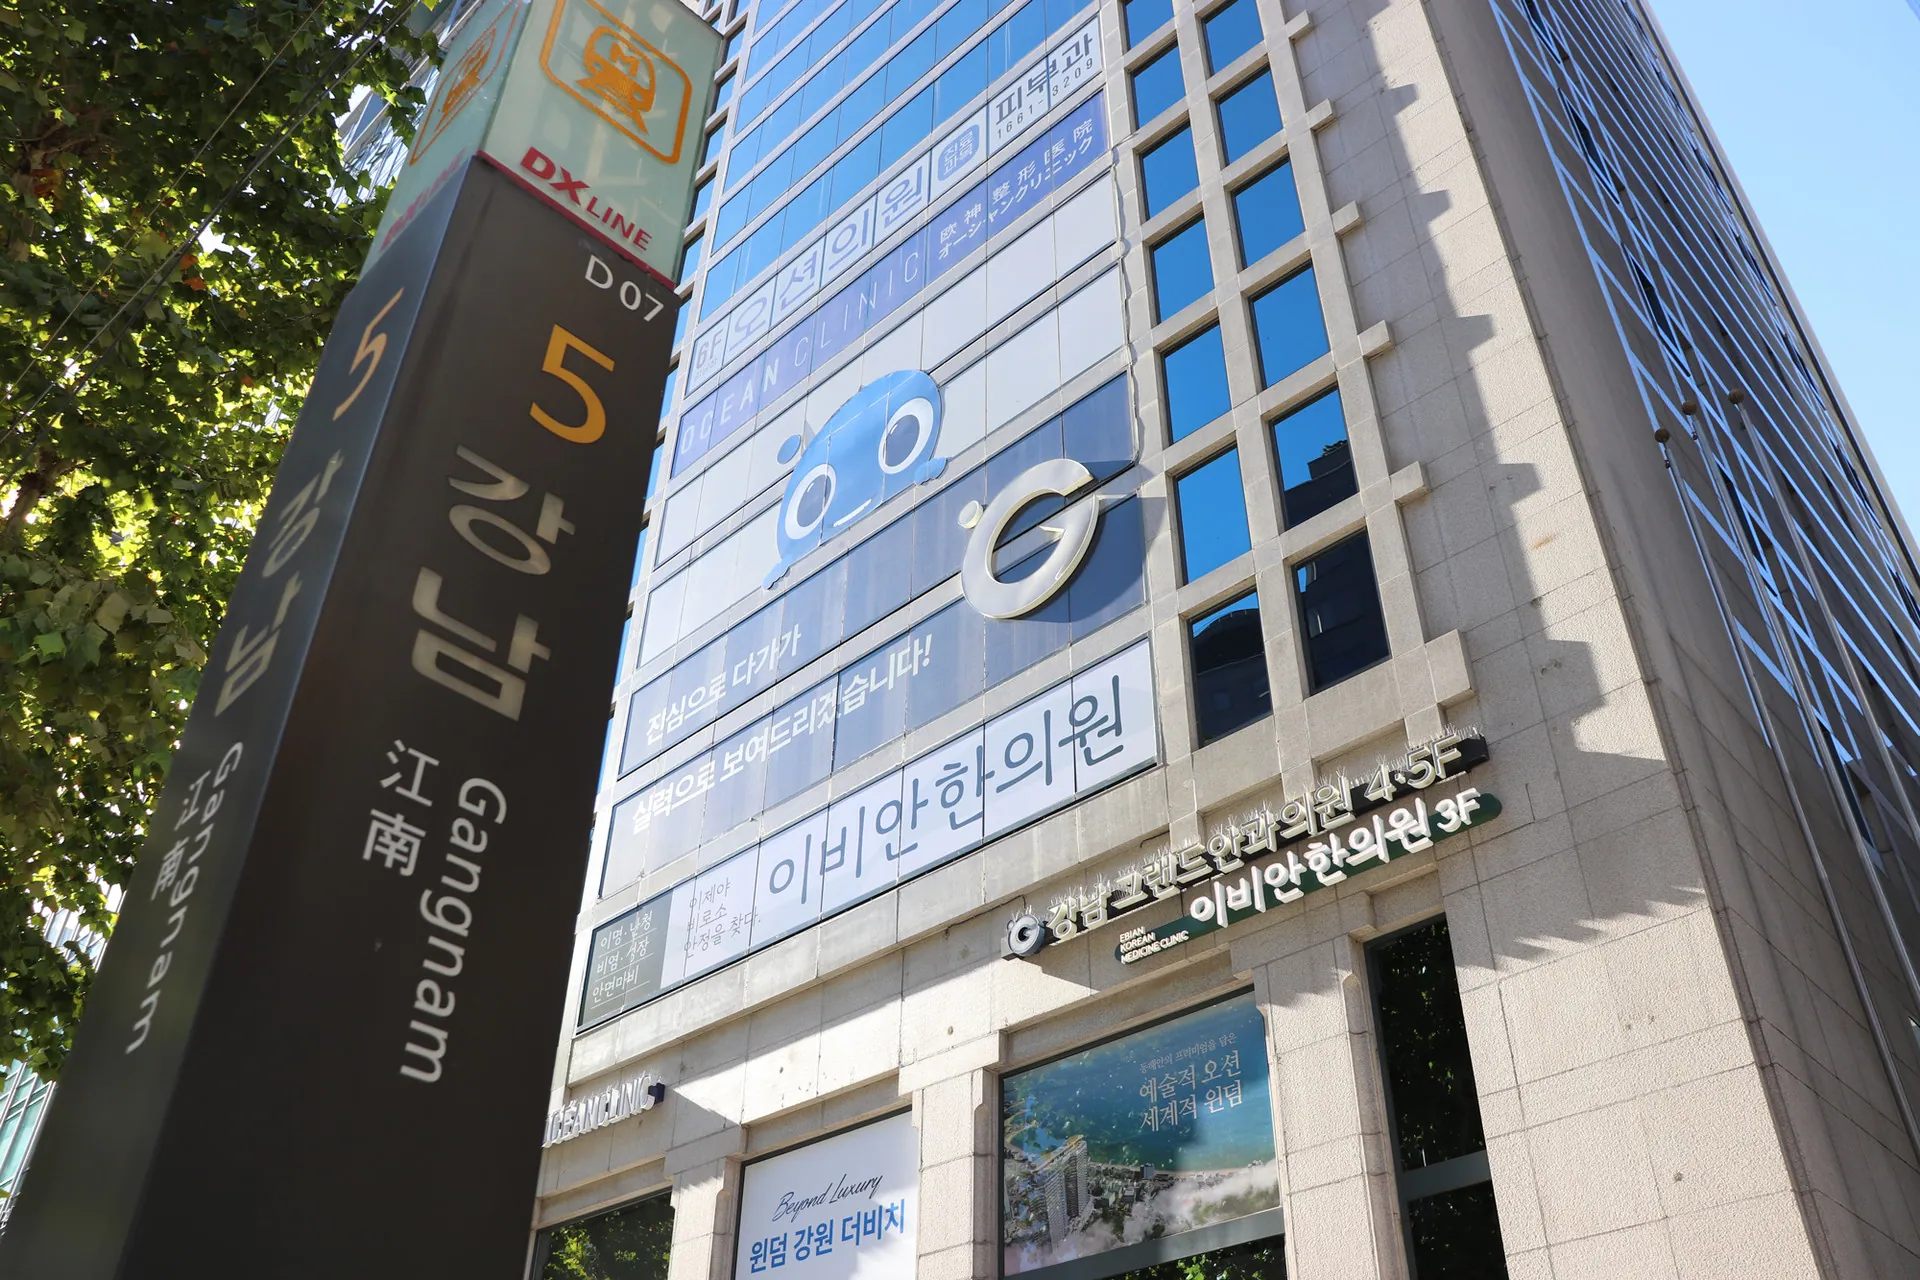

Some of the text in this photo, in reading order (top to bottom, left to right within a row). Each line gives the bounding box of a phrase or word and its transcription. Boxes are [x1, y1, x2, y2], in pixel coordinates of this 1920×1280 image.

[995, 33, 1093, 125] 피부과
[997, 57, 1093, 140] 1661-3209
[729, 165, 923, 352] 오션의원
[333, 287, 404, 421] 5
[529, 324, 615, 444] 5
[680, 252, 919, 456] OCEAN CLINIC
[696, 329, 723, 369] 6F
[215, 449, 344, 717] 강남
[412, 445, 575, 721] 강남
[646, 624, 802, 746] 진심으로 다가가
[632, 633, 932, 836] 실력으로 보여드리겠습니다!
[363, 739, 440, 877] 江南
[769, 675, 1124, 905] 이비안한의원
[126, 742, 243, 1054] Gangnam
[689, 878, 731, 910] 이제야
[1190, 787, 1481, 928] 이비안한의원 3F
[400, 777, 507, 1083] Gangnam
[684, 905, 761, 959] 안정을 찾다.
[687, 903, 727, 934] 비로소
[1120, 926, 1146, 943] EBIAN
[1120, 932, 1156, 954] KOREAN
[1121, 930, 1189, 964] MEDICINE CLINIC
[592, 964, 639, 1003] 안면마비
[1139, 1050, 1241, 1103] 예술적 오션
[1140, 1079, 1243, 1132] 세계적 윈덤
[750, 1198, 906, 1274] 윈덤 강원 더비치
[772, 1173, 883, 1223] Beyond Luxury
